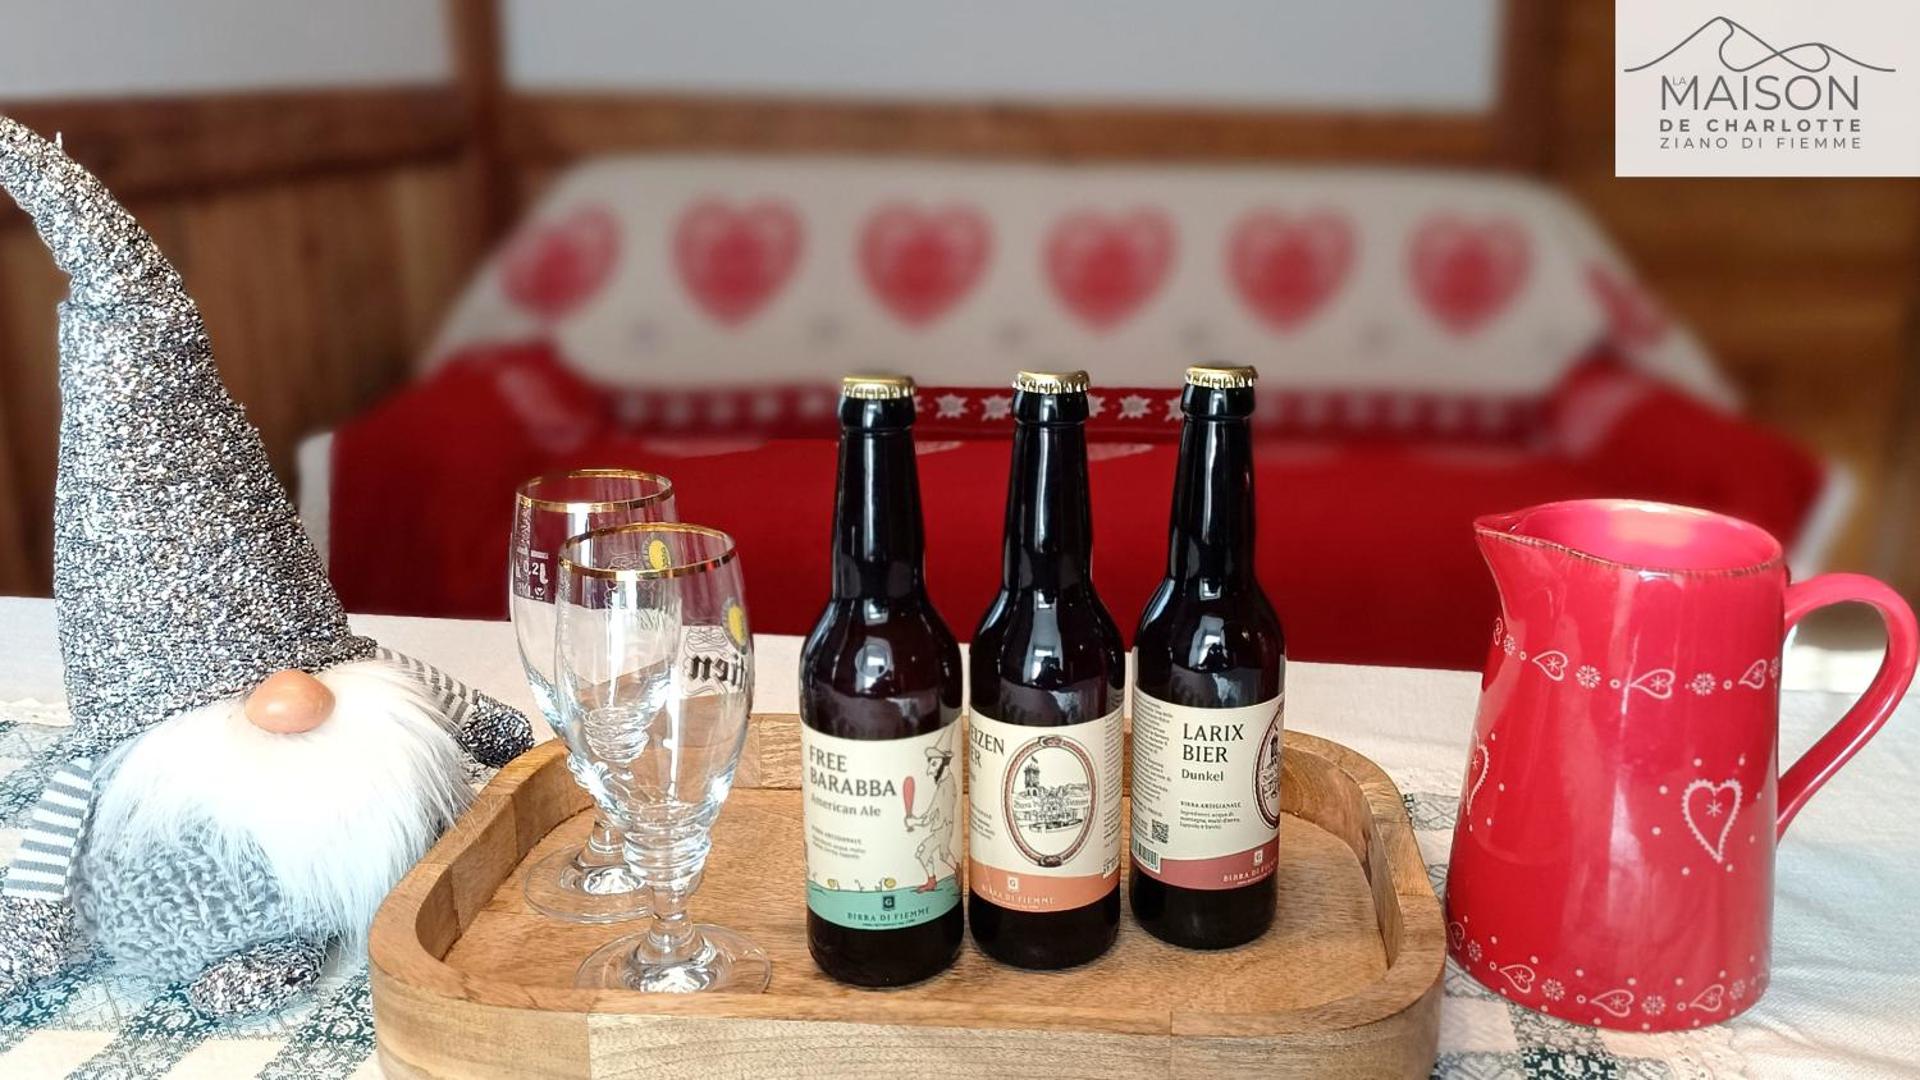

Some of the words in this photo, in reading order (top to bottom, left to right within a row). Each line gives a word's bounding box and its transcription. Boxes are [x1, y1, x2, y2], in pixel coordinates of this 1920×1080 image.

[970, 724, 1004, 755] EIZEN
[1183, 723, 1244, 742] LARIX
[809, 745, 848, 773] FREE
[970, 744, 982, 768] ER
[1182, 744, 1228, 763] BIER
[810, 767, 897, 797] BARABBA
[1181, 769, 1224, 782] Dunkel
[810, 793, 857, 815] American
[860, 804, 881, 817] Ale
[880, 913, 891, 921] DI
